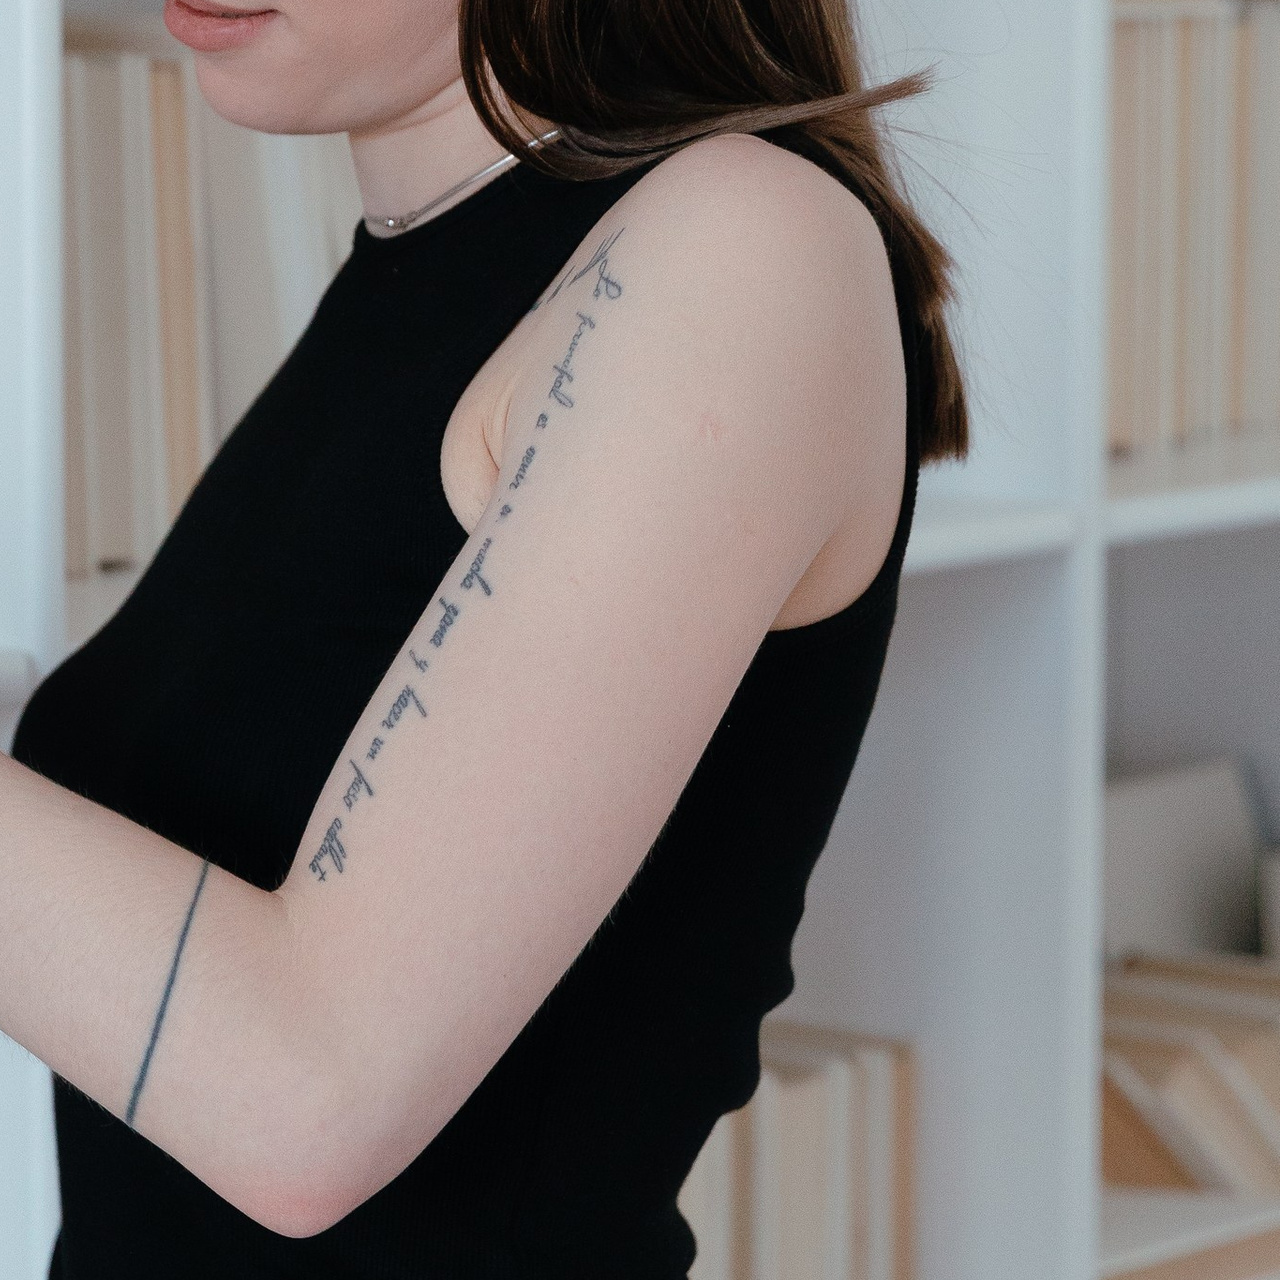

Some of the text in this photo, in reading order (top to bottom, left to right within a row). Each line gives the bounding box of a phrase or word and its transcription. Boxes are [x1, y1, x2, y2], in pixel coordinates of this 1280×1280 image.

[408, 648, 430, 675] y
[381, 683, 430, 731] hacer
[366, 736, 385, 761] un
[342, 758, 376, 813] paso
